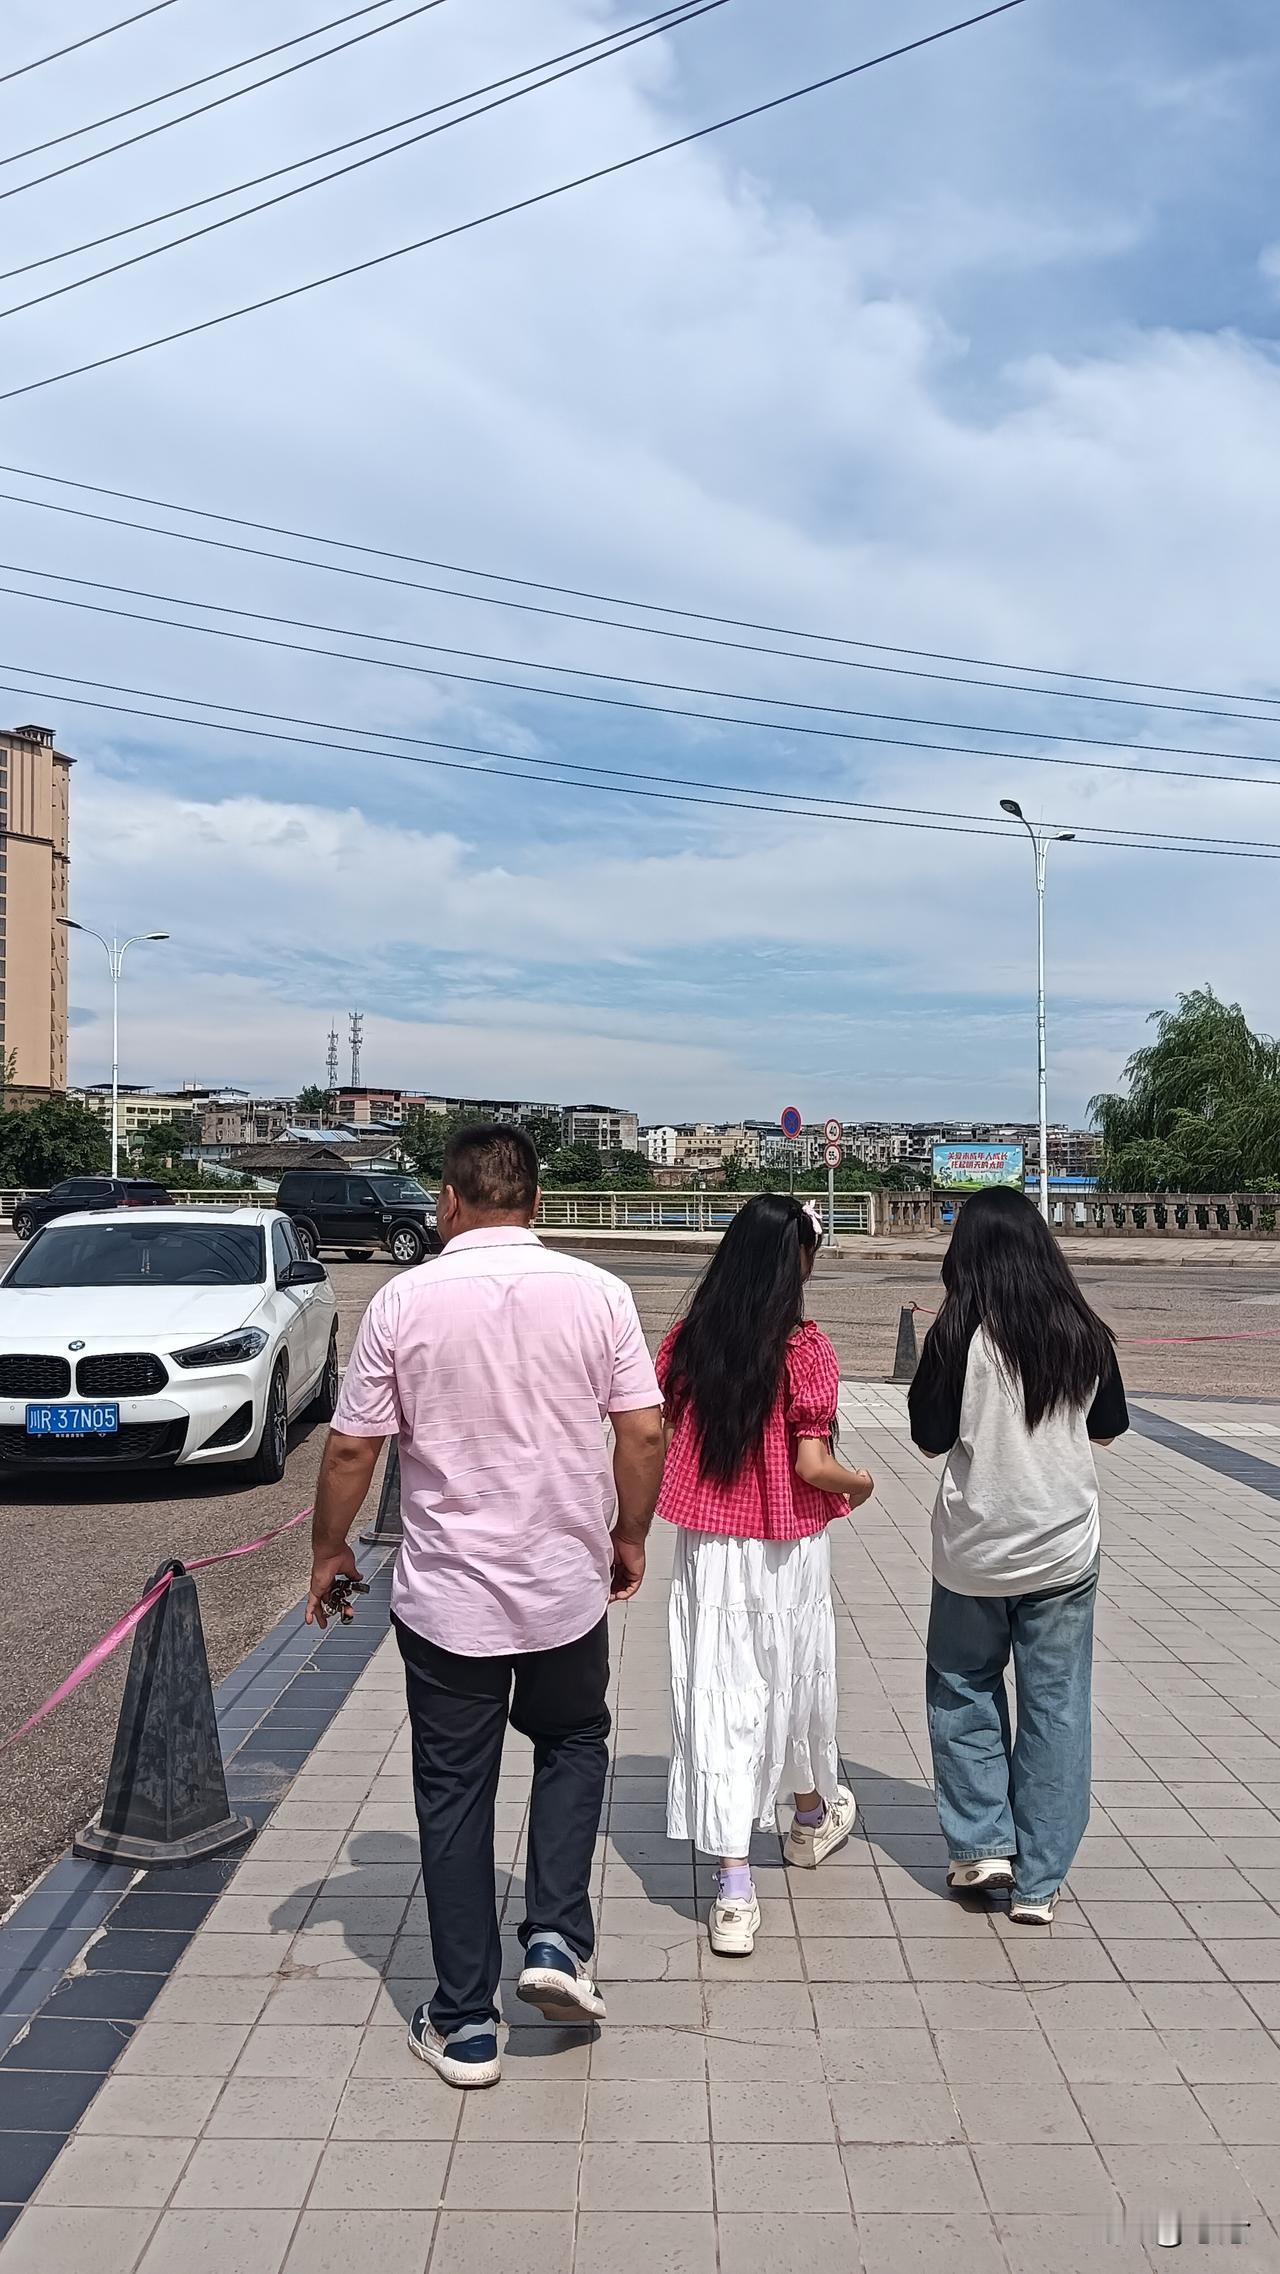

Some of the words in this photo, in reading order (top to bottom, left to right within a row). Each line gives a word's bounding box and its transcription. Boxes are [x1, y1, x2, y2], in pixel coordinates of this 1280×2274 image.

[829, 1126, 837, 1136] 40
[947, 1152, 1008, 1160] 关爱未成年人成长
[951, 1161, 1004, 1169] 托起明天的太阳
[30, 1408, 115, 1429] 川R·37N05
